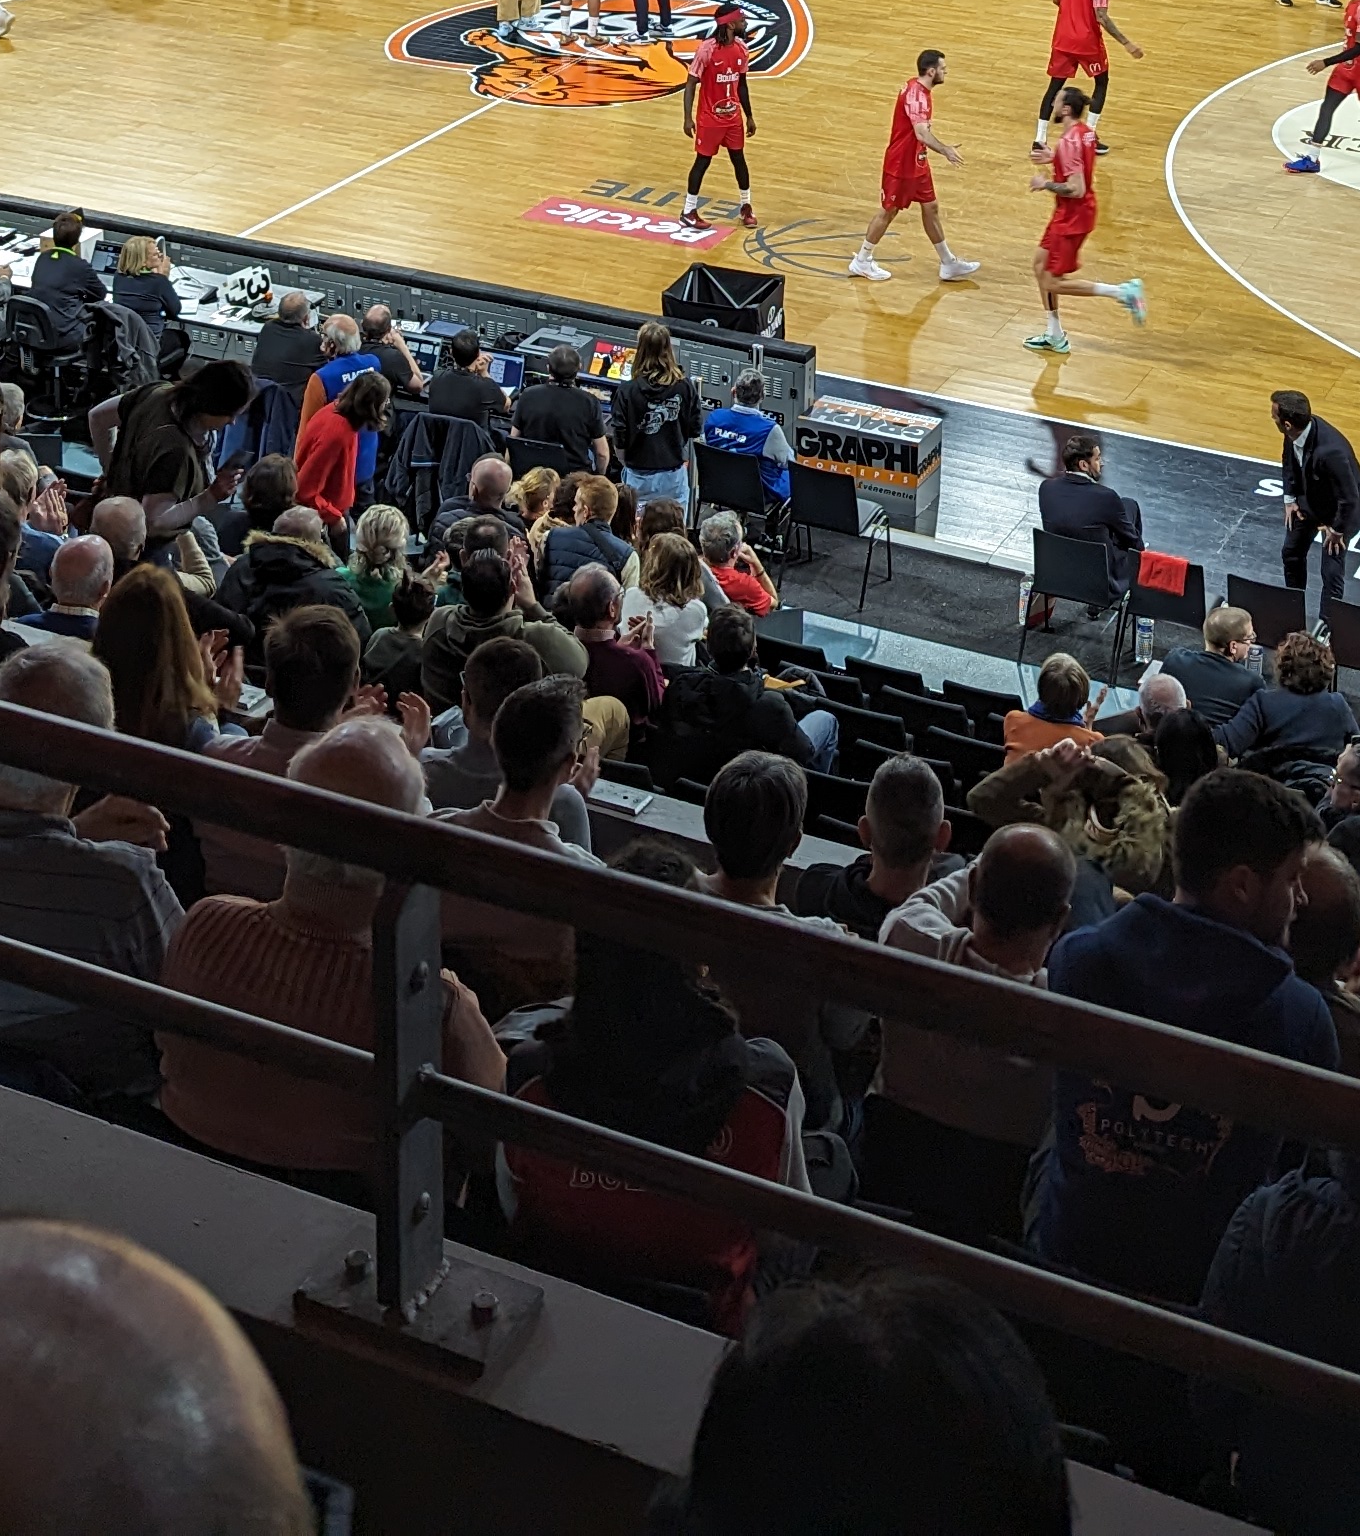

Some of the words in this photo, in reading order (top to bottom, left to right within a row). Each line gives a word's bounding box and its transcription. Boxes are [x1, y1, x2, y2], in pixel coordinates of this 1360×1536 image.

[796, 427, 919, 475] GRAPHI
[802, 459, 909, 484] CONCEPTS
[1099, 1117, 1210, 1154] POLYTECH
